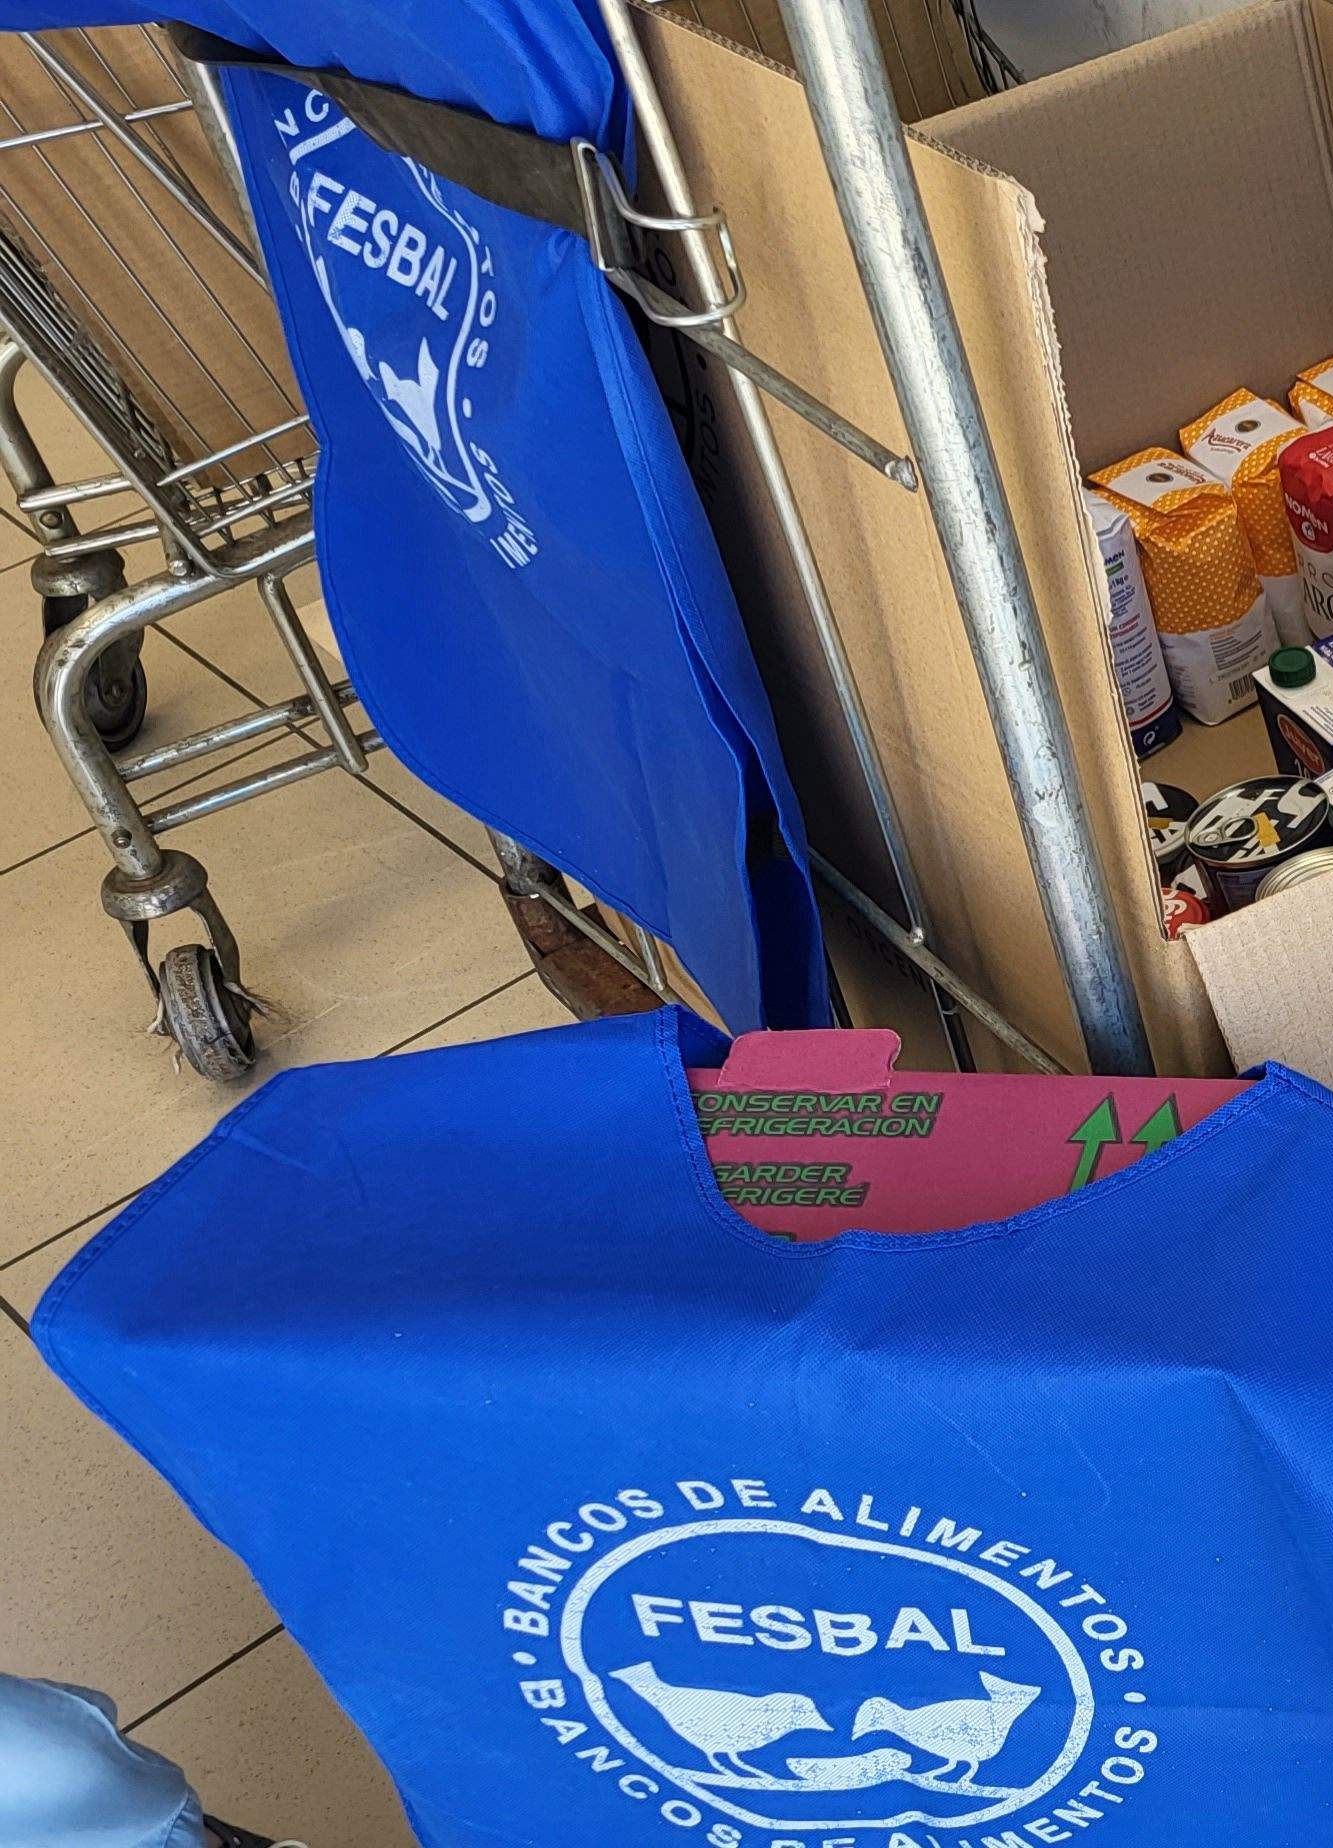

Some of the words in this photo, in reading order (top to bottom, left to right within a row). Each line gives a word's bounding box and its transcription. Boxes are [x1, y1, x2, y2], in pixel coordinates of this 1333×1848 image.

[307, 170, 457, 321] FESBAL
[692, 1092, 886, 1114] ONSERVAR
[890, 1092, 943, 1114] EN
[699, 1116, 936, 1138] EFRIGERACION
[503, 1488, 664, 1637] BANCOS
[675, 1479, 777, 1511] DE
[801, 1488, 1145, 1671] ALIMENTOS
[631, 1594, 1006, 1657] FESBAL
[519, 1679, 742, 1848] BANCOS
